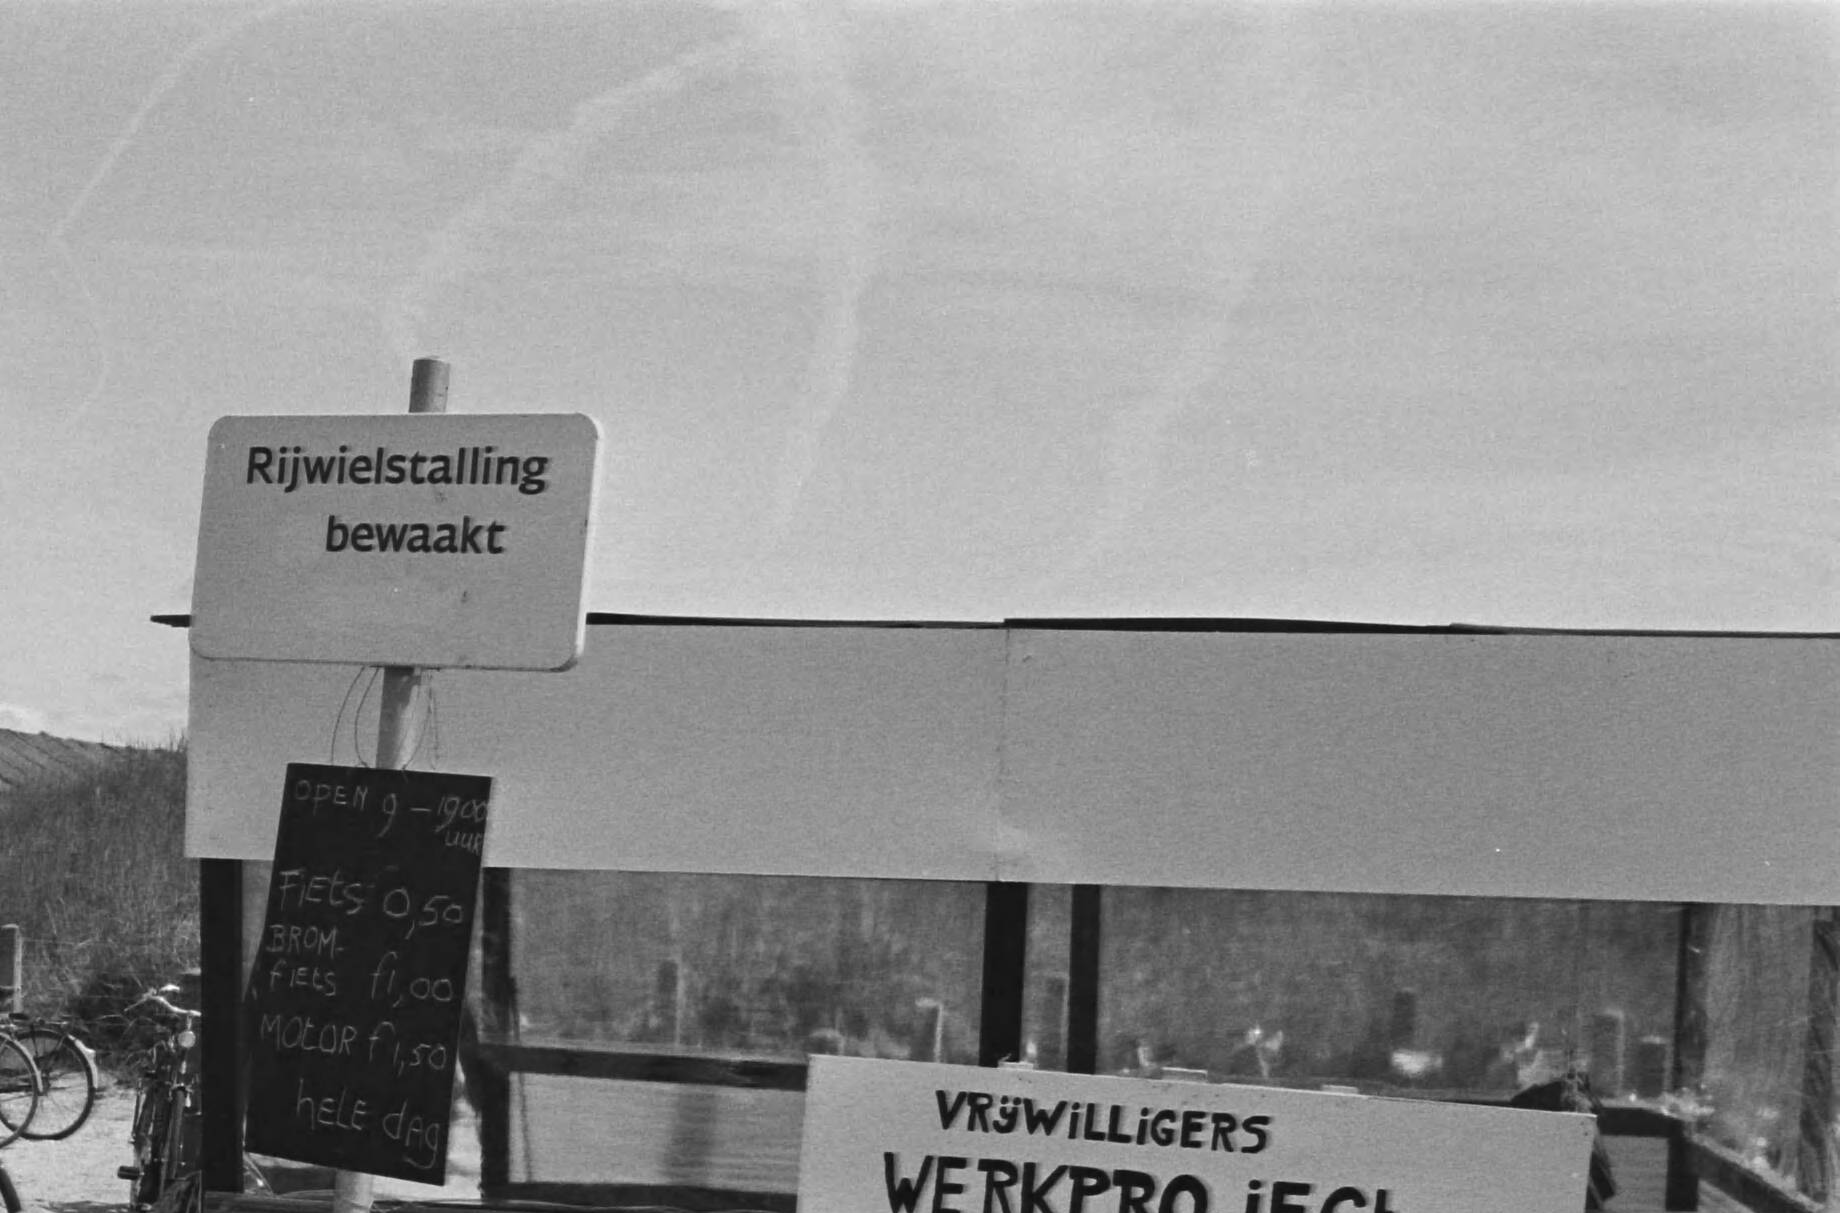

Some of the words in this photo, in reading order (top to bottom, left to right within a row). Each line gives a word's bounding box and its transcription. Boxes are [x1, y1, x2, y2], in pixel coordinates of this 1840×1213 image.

[246, 444, 550, 496] Rijwielstalling
[325, 514, 507, 555] bewaakt
[376, 792, 398, 840] 9
[382, 886, 464, 941] 0,50
